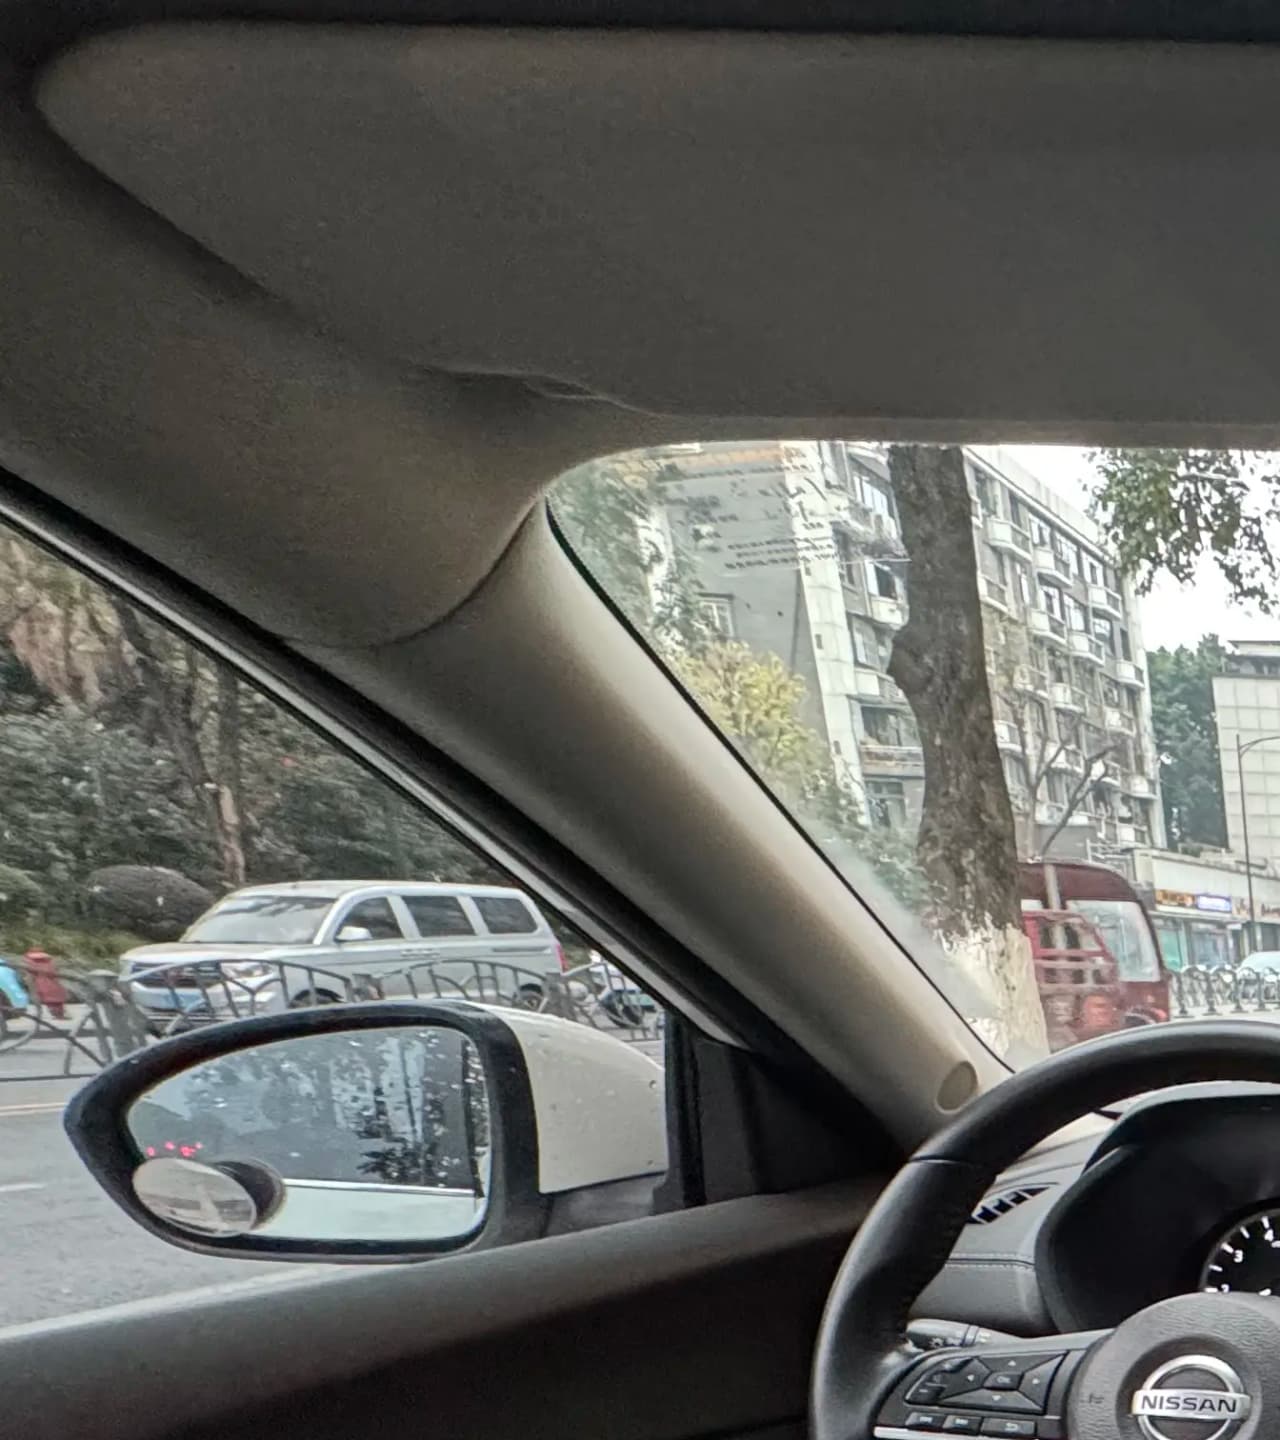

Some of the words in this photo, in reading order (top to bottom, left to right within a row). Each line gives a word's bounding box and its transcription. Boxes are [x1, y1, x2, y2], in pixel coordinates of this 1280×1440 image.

[1264, 1229, 1274, 1241] 4
[1233, 1250, 1243, 1263] 3
[1141, 1395, 1237, 1413] NISSAN
